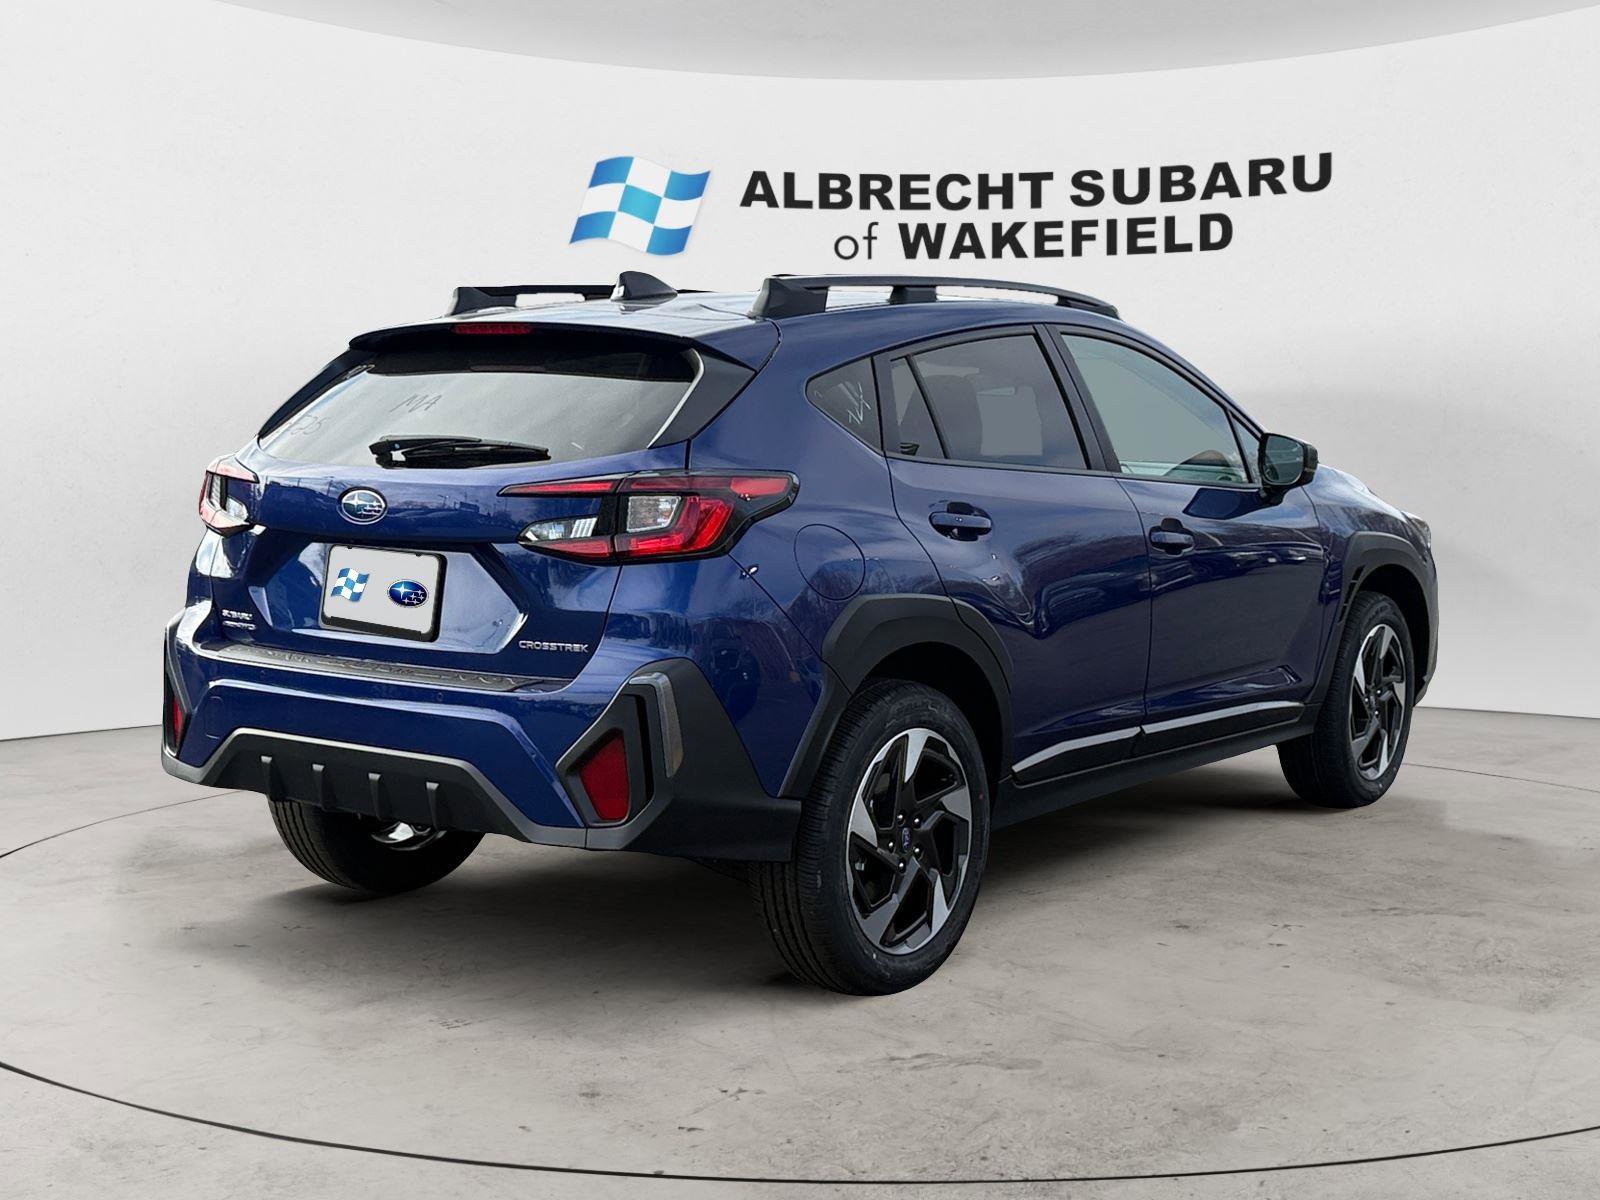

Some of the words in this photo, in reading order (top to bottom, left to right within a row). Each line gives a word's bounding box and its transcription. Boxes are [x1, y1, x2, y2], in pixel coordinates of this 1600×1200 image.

[739, 170, 1054, 211] ALBRECHT
[1069, 152, 1333, 208] SUBARU
[834, 222, 879, 261] of
[898, 213, 1234, 260] WAKEFIELD
[518, 640, 589, 653] CROSSTREK
